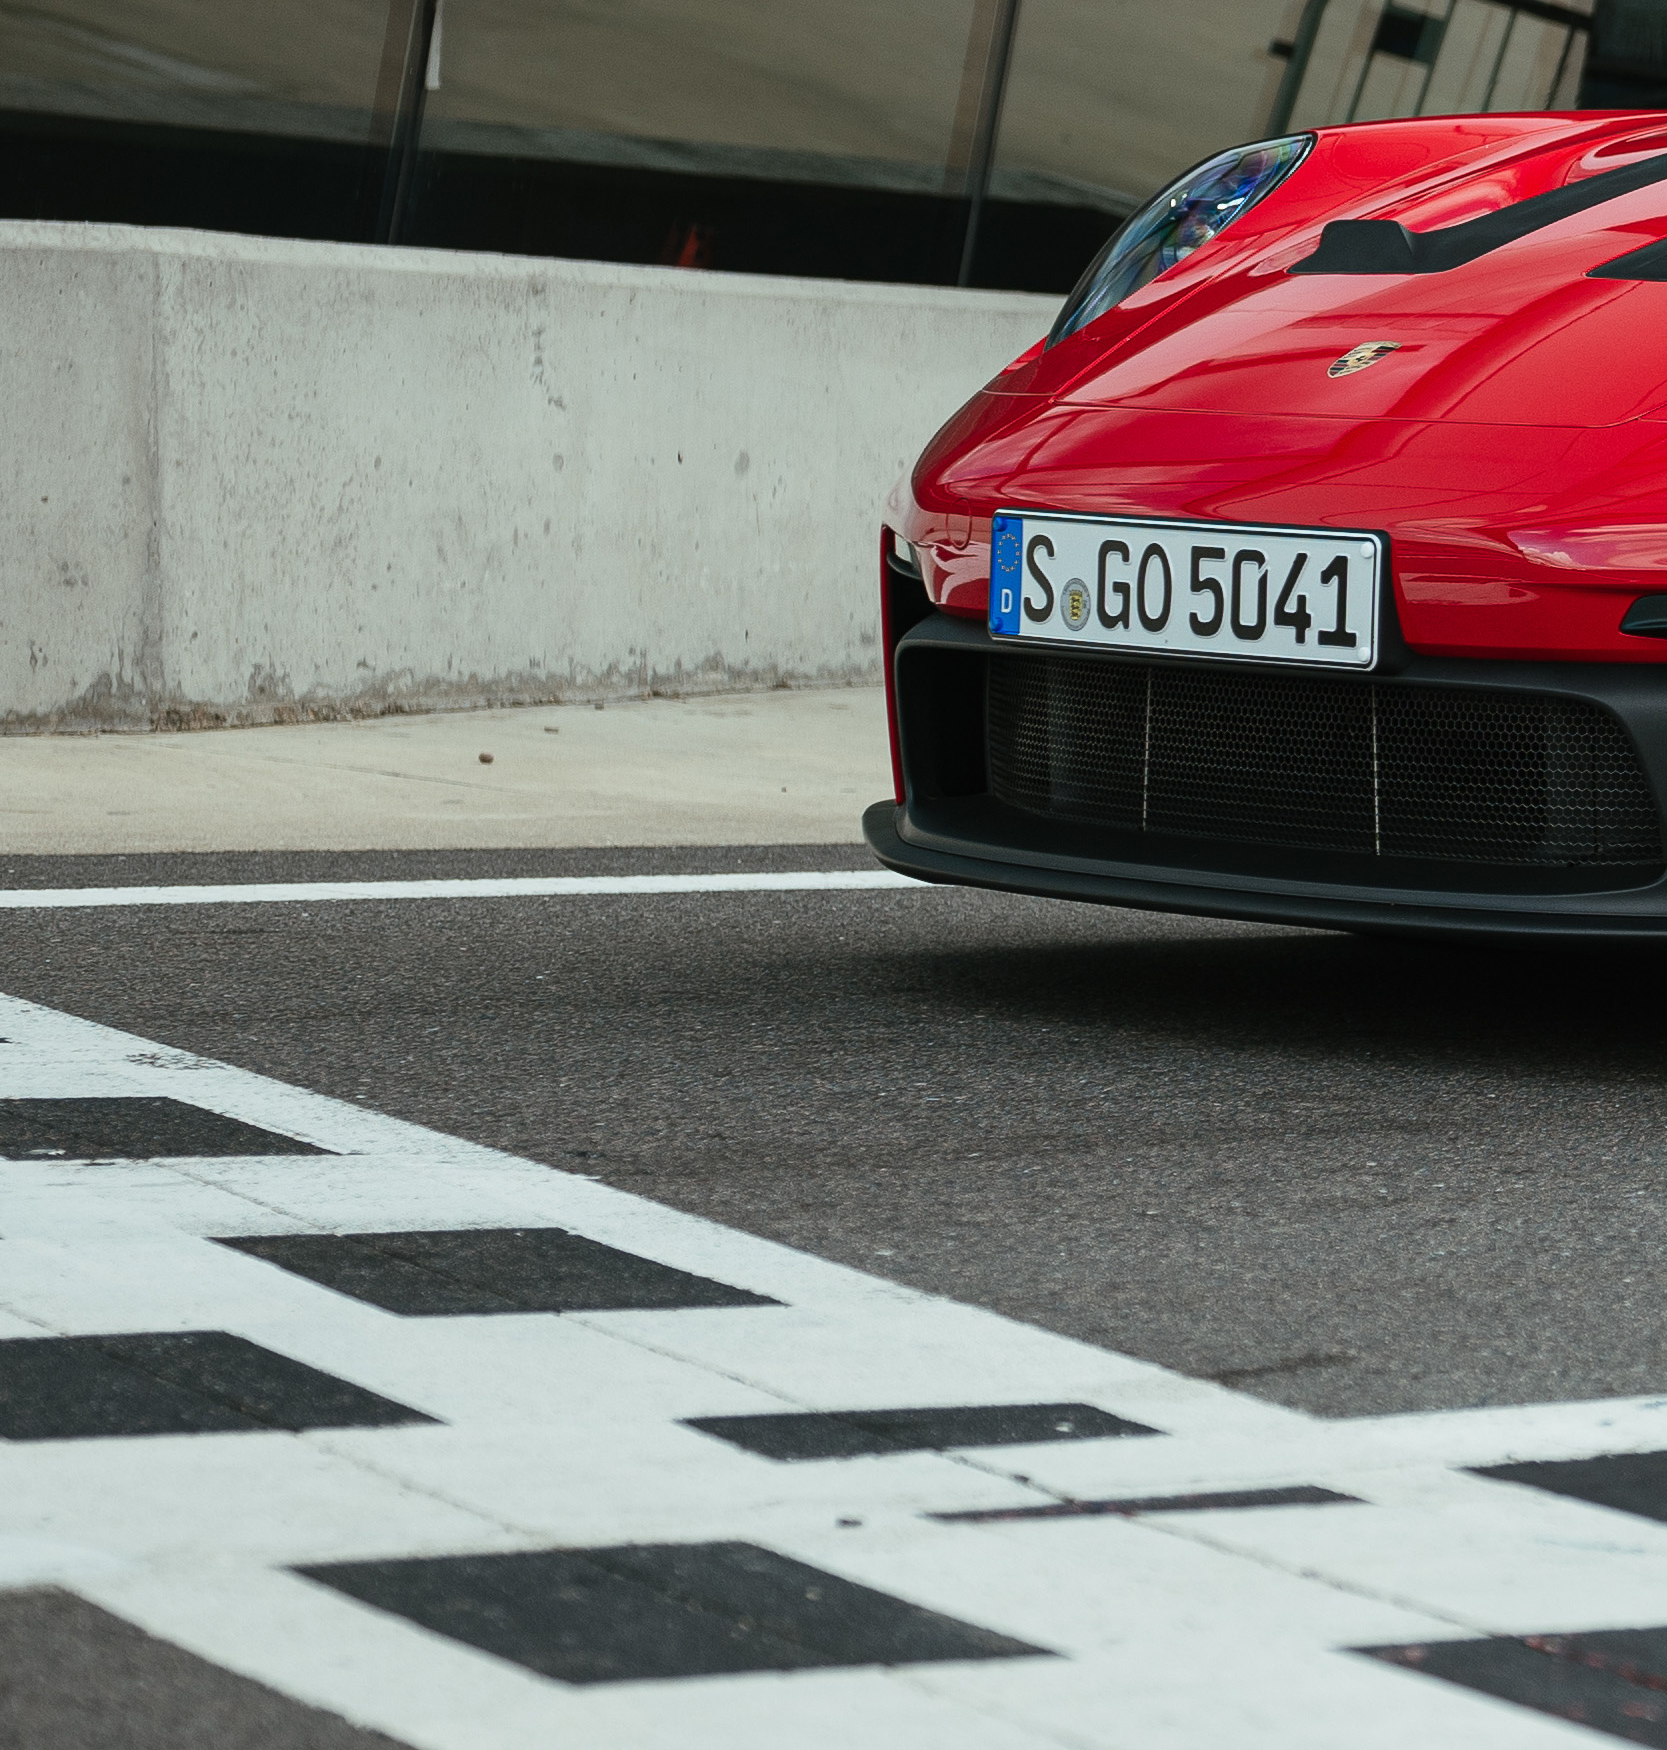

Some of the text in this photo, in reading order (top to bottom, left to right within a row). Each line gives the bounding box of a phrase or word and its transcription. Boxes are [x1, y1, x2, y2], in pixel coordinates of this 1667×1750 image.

[1000, 588, 1012, 613] D
[1023, 534, 1055, 622] S
[1096, 539, 1172, 633] GO
[1188, 545, 1358, 647] 5041
